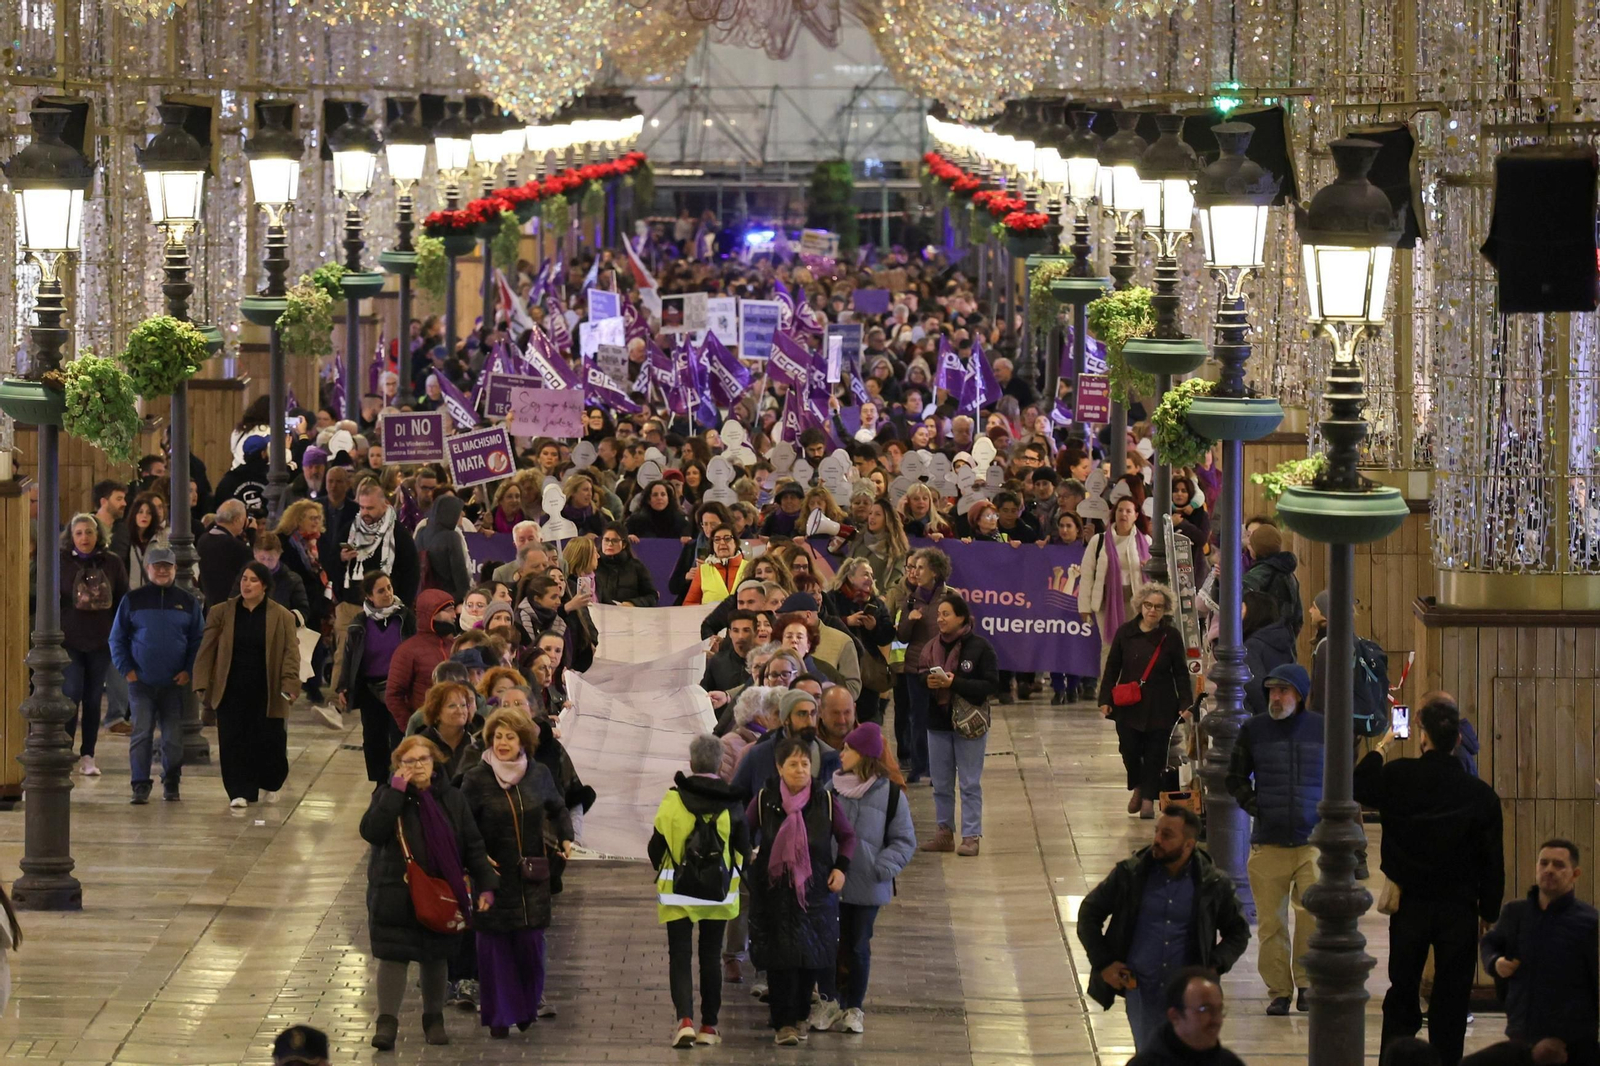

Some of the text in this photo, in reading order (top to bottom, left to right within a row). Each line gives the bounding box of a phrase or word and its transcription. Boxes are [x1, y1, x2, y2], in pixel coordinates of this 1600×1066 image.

[533, 355, 562, 389] CCOO
[712, 358, 740, 393] CCOO
[446, 399, 476, 428] CCOO
[494, 402, 504, 414] TE
[395, 418, 431, 437] DI NO
[406, 440, 435, 448] Violencia
[416, 448, 442, 457] mujeres
[452, 433, 503, 454] EL MACHISMO
[456, 454, 486, 473] MATA
[954, 587, 1032, 609] menos,
[981, 615, 1092, 637] queremos
